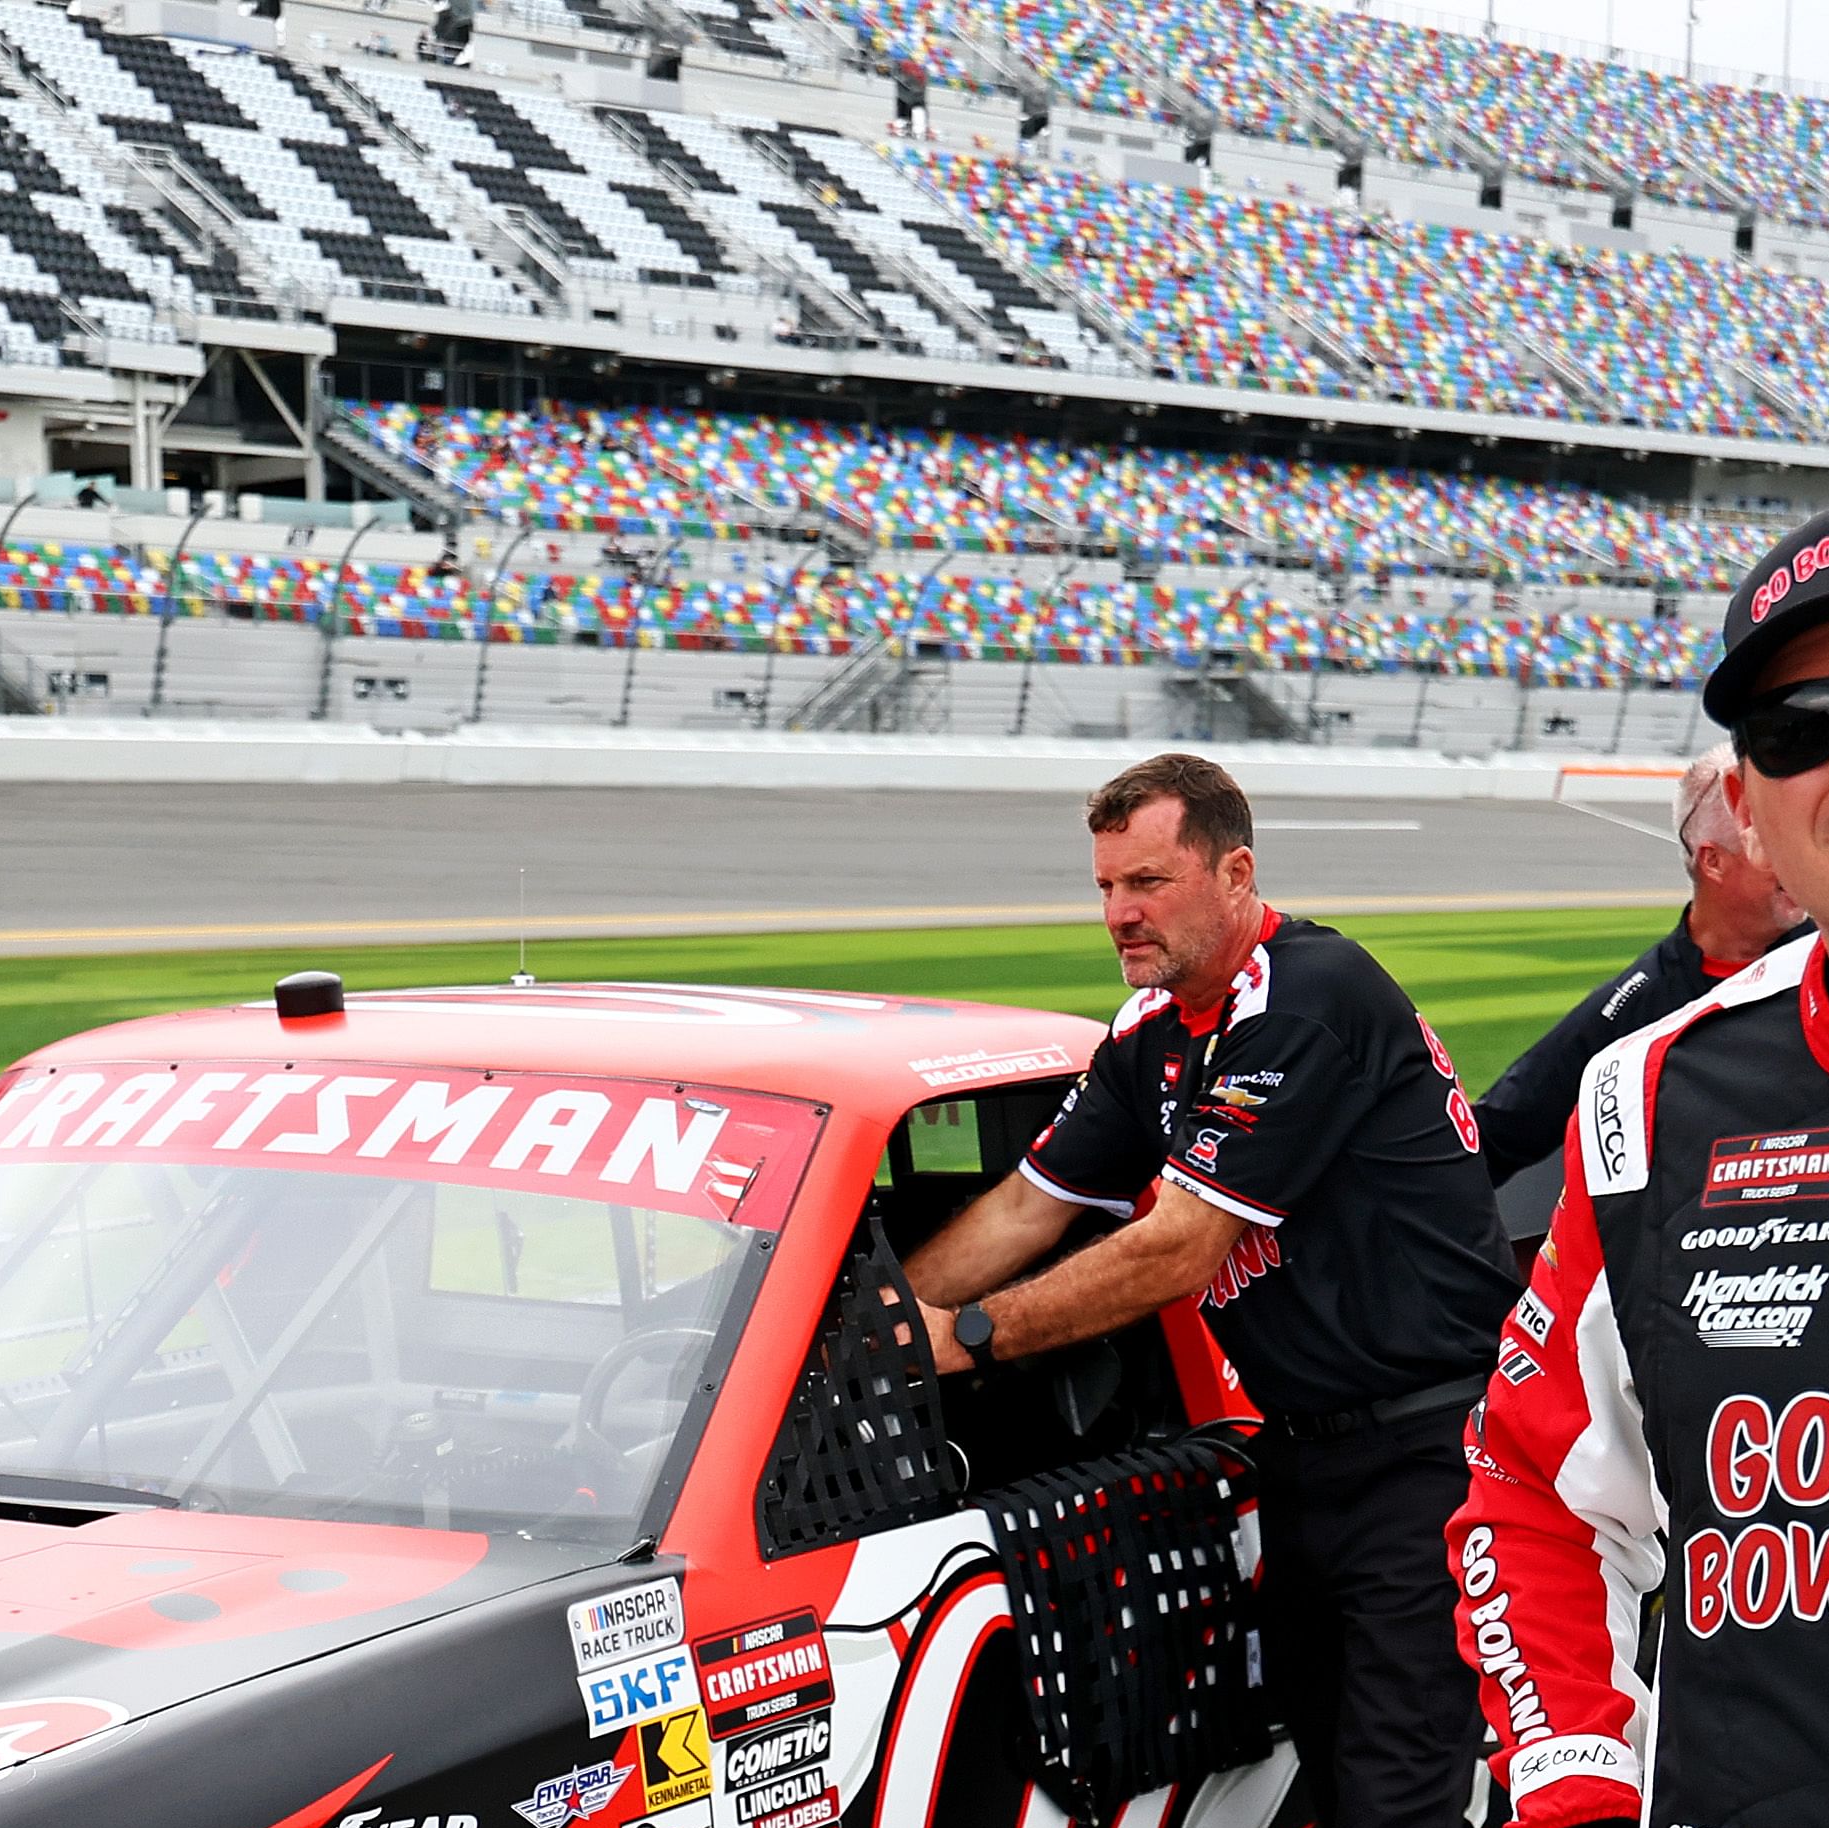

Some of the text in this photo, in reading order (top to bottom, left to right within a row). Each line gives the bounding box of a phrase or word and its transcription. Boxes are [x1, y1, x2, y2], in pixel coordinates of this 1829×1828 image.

[1750, 567, 1792, 624] GO
[1594, 1058, 1627, 1182] sparco
[1760, 1133, 1809, 1150] NASCAR
[1680, 1264, 1829, 1318] Hendrick
[1696, 1304, 1814, 1332] Cars.com
[1461, 1525, 1497, 1598] GO
[602, 1589, 668, 1627] NASCAR
[580, 1617, 676, 1661] RACE TRUCK
[744, 1623, 784, 1653] NASCAR
[589, 1655, 687, 1727] SKF
[706, 1643, 823, 1702] CRAFTSMAN
[745, 1692, 798, 1722] TRUCK SERIES
[726, 1720, 829, 1783] COMETIC
[1520, 1742, 1619, 1781] SECOND
[536, 1764, 612, 1809] FIVE STAR
[647, 1775, 712, 1808] KENNAMETAL
[739, 1772, 822, 1822] LINCOLN
